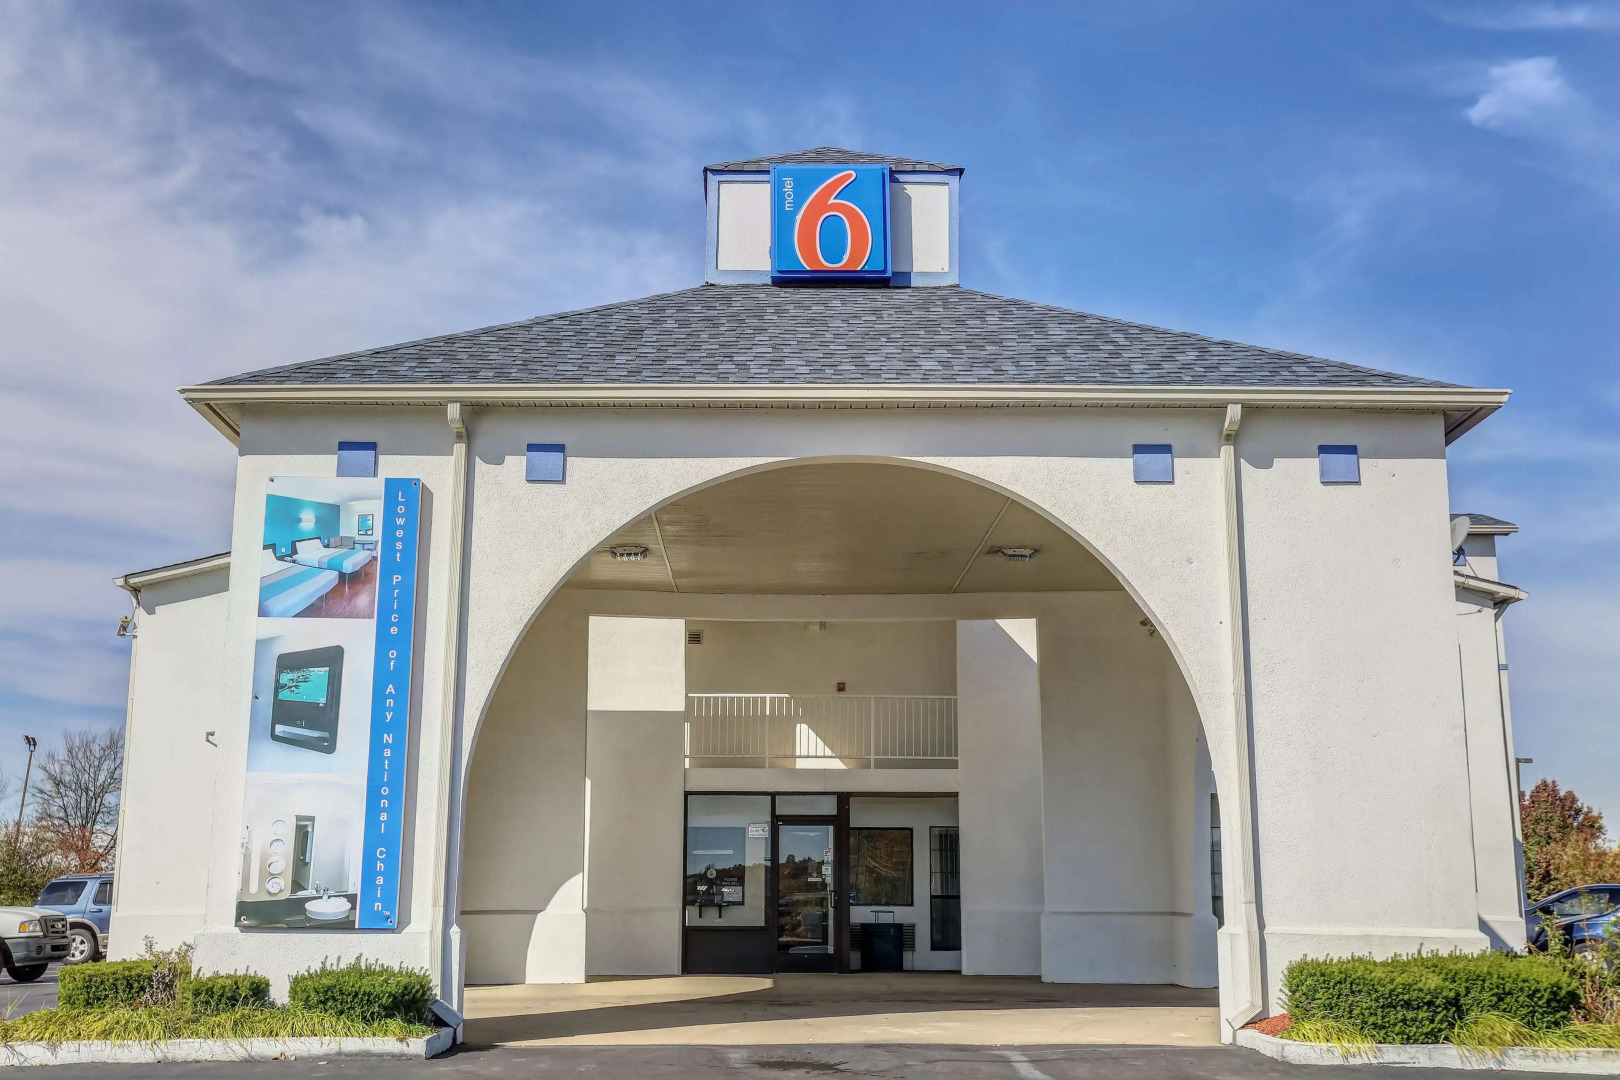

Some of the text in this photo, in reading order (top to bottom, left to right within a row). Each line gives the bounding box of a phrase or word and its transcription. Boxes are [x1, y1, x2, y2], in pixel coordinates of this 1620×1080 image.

[782, 177, 794, 211] motel
[793, 169, 873, 271] 6
[395, 491, 405, 562] Lowest
[390, 575, 402, 634] Price
[388, 649, 397, 671] of
[385, 684, 395, 722] Any
[379, 733, 393, 833] National
[374, 847, 387, 911] Chain
